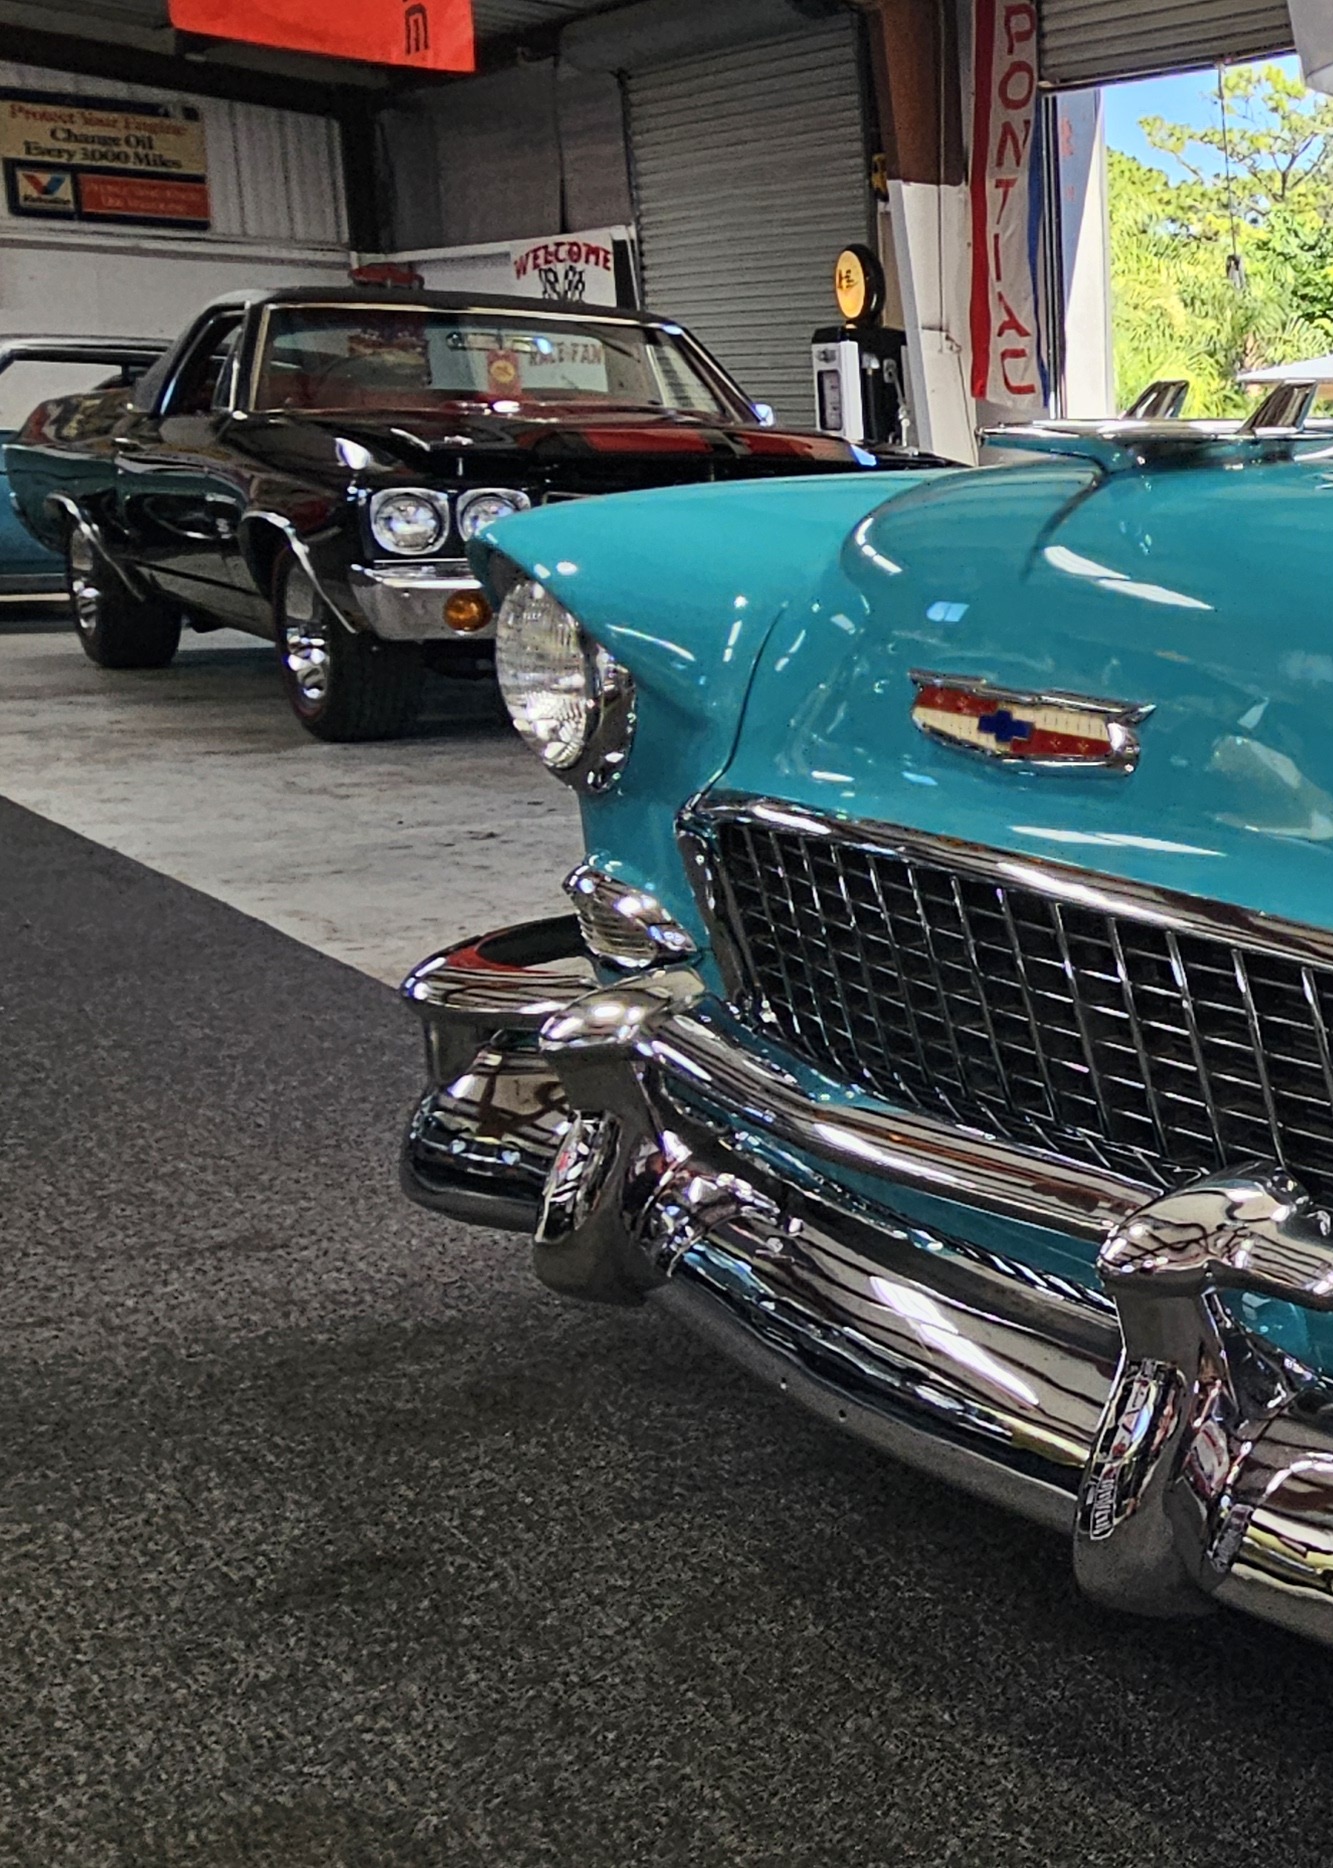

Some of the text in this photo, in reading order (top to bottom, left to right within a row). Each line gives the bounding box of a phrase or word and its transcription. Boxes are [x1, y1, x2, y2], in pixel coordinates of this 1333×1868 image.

[10, 103, 75, 125] Protect
[78, 109, 119, 129] Your
[50, 126, 155, 151] Change Oil
[23, 140, 78, 162] Every
[133, 151, 183, 169] Miles
[993, 3, 1037, 396] PONTIAC
[514, 241, 612, 281] WELCOME
